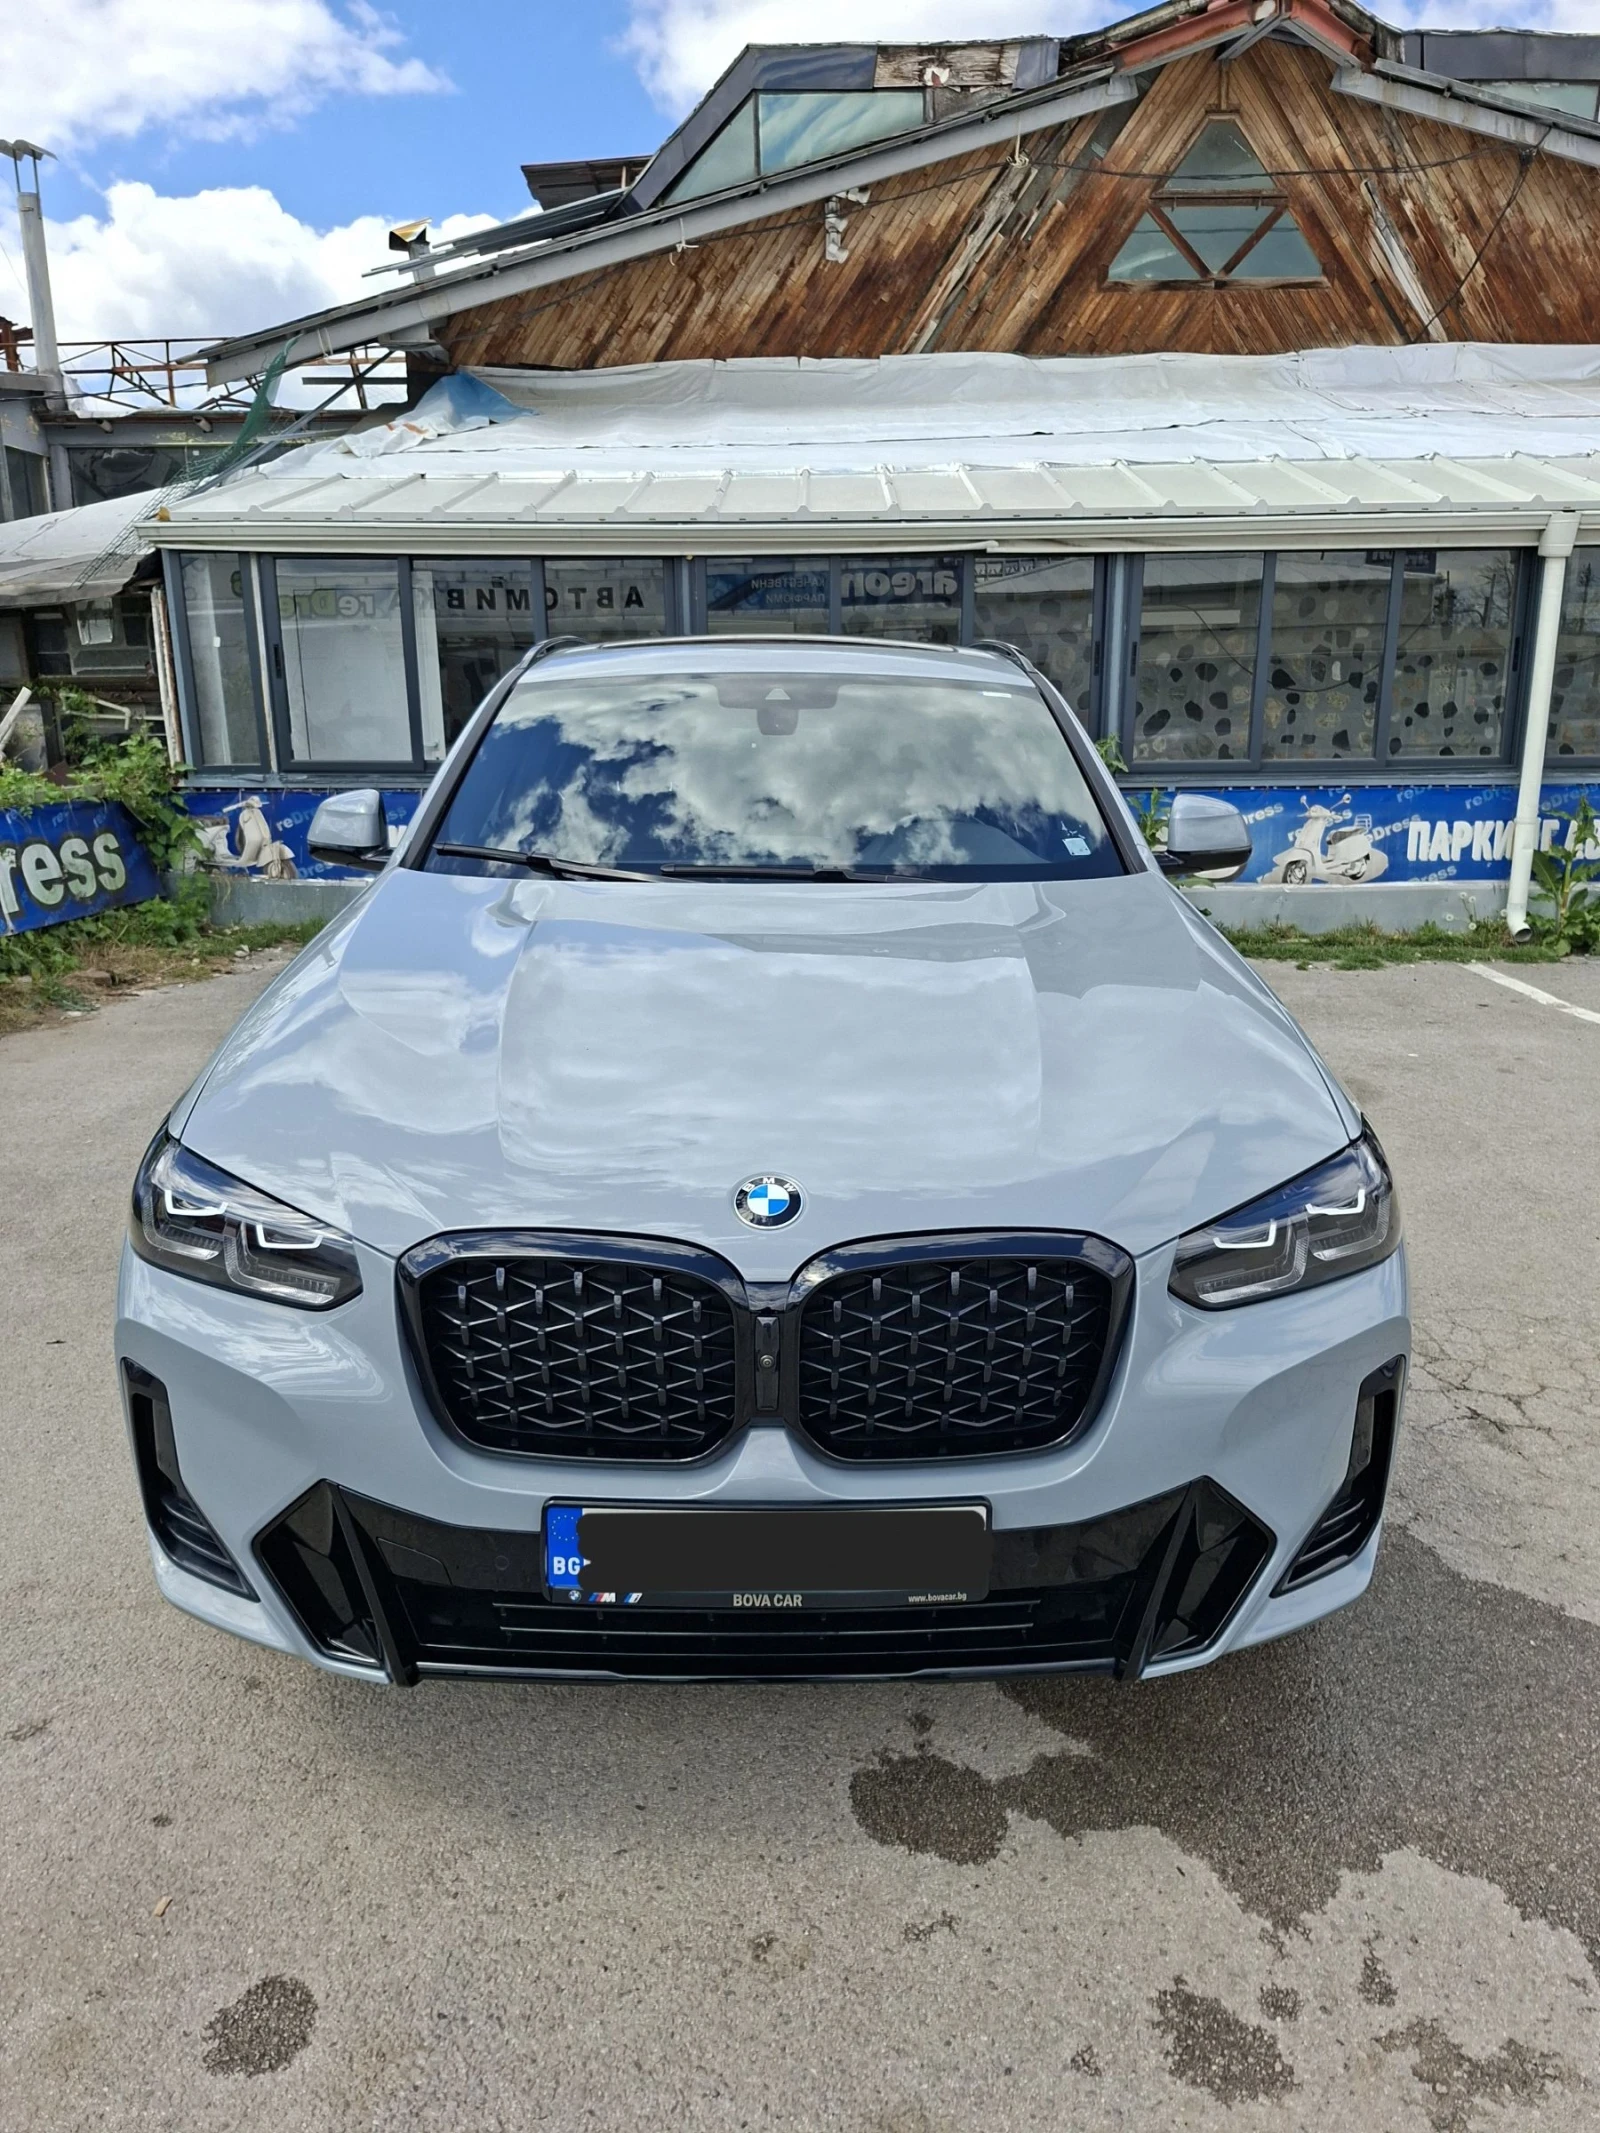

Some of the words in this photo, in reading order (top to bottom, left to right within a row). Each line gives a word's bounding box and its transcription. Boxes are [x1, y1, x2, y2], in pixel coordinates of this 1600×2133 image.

[1407, 818, 1560, 862] ПАРКИГ
[553, 1556, 581, 1576] BG
[733, 1594, 771, 1607] BOVA
[773, 1594, 803, 1607] CAR
[908, 1592, 967, 1603] www.bovacar.bg
